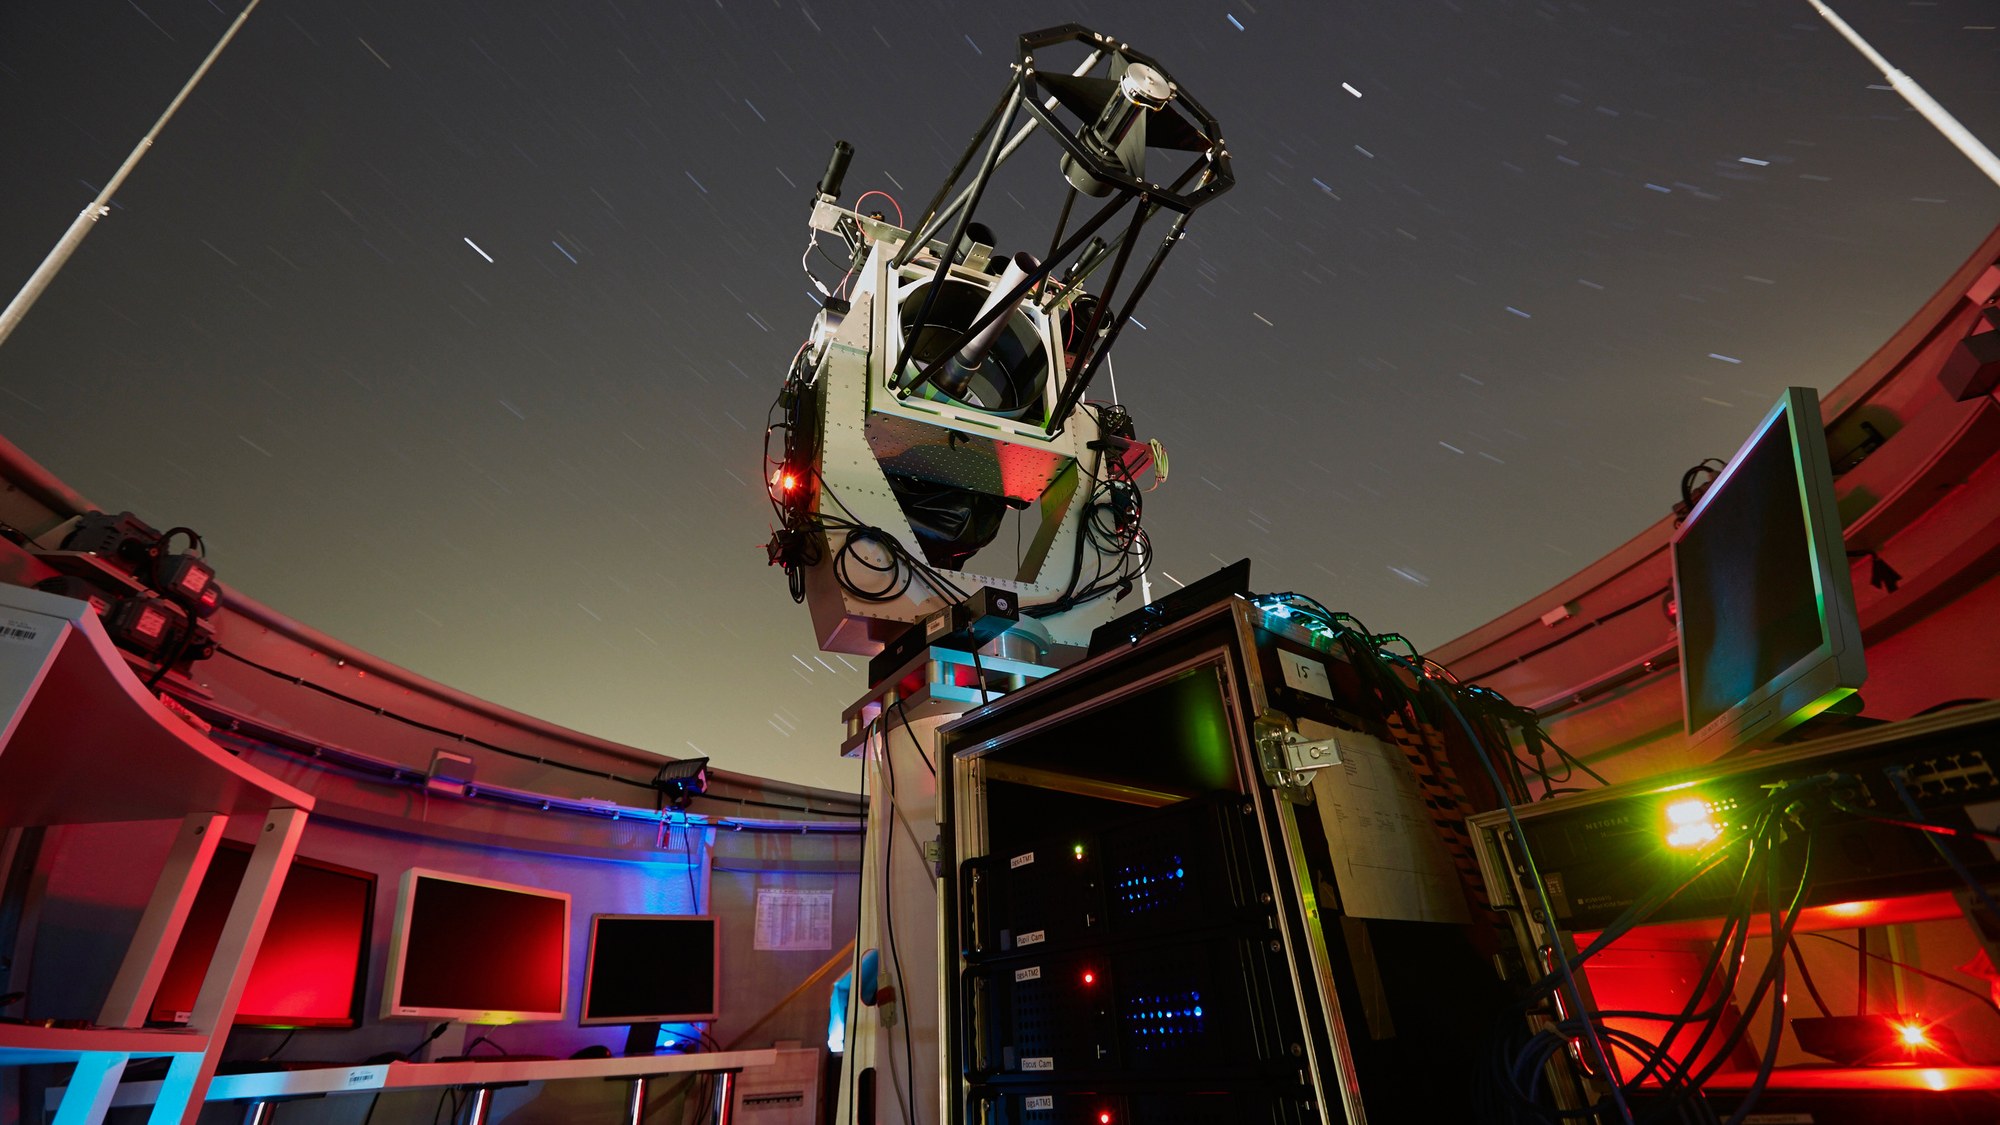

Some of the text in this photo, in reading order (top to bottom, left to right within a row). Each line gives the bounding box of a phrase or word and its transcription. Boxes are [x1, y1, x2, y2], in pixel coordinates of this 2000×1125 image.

[1585, 816, 1630, 830] NETGEAR
[1031, 933, 1043, 942] Cam
[1038, 1059, 1052, 1068] Cam
